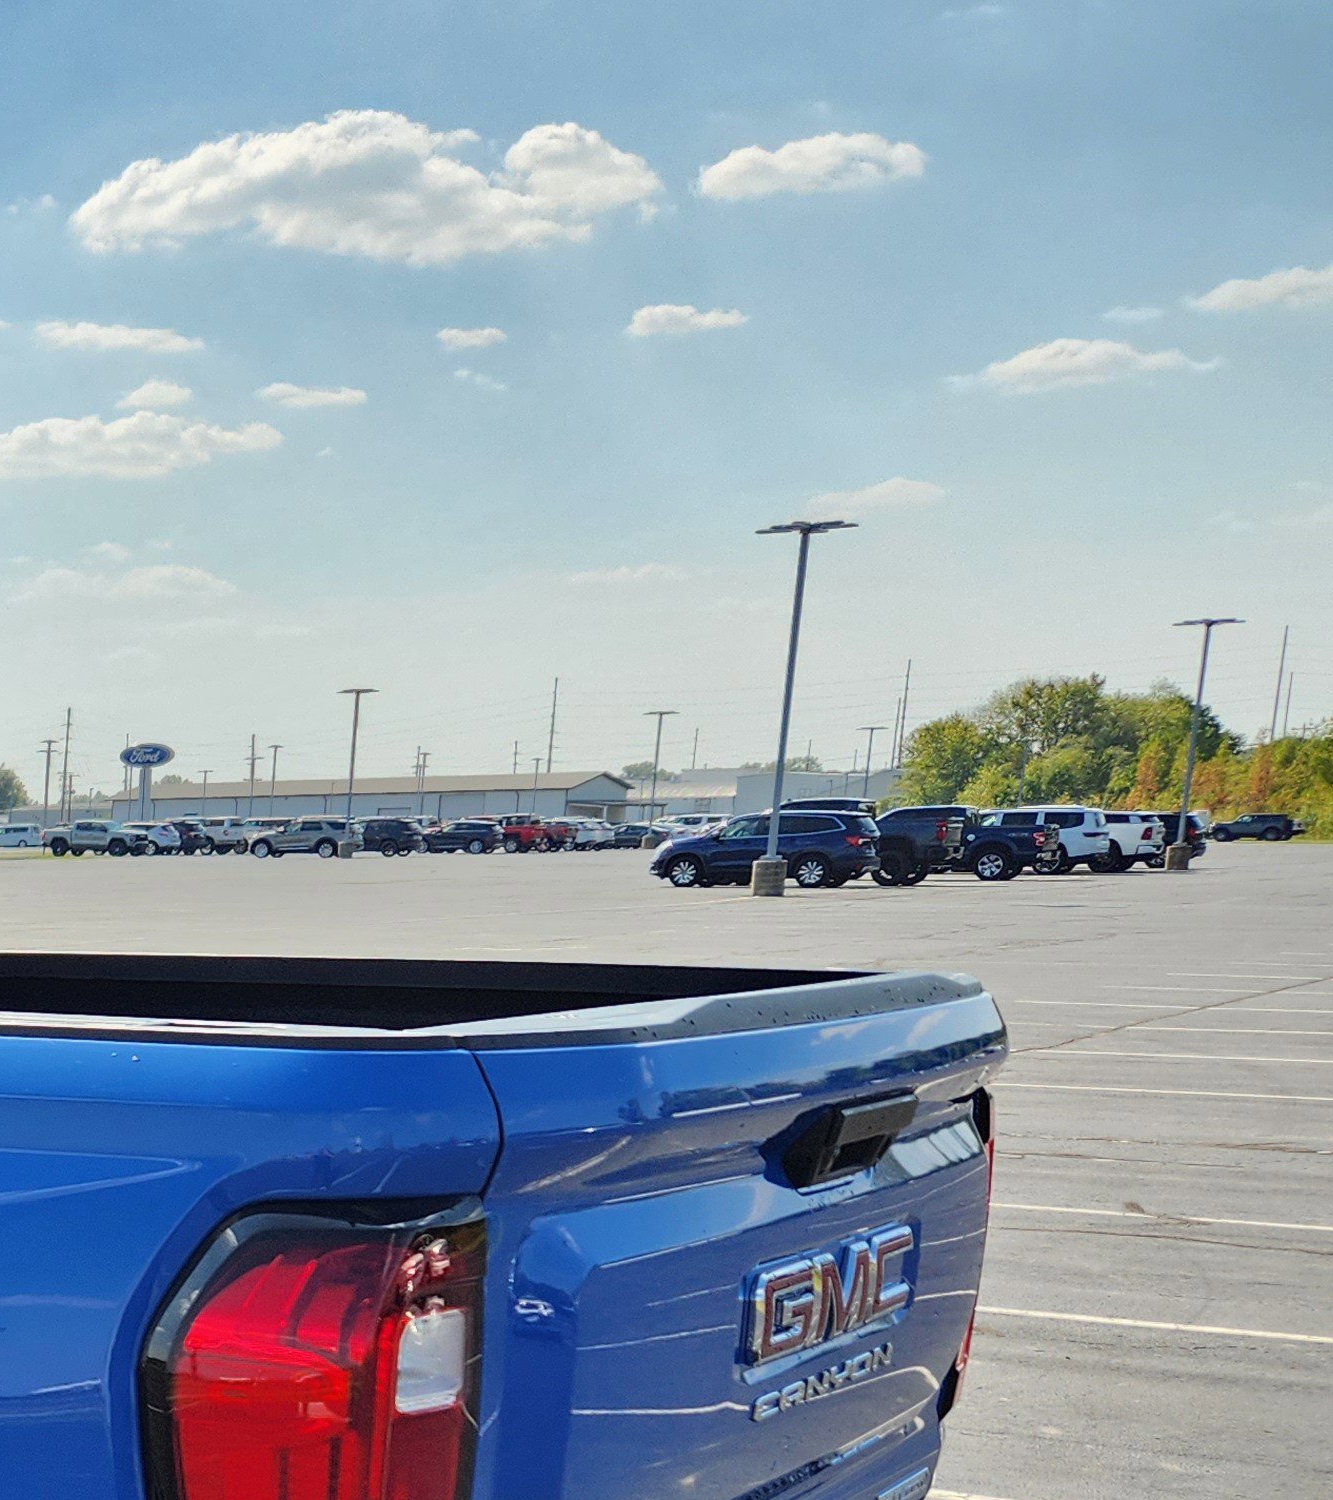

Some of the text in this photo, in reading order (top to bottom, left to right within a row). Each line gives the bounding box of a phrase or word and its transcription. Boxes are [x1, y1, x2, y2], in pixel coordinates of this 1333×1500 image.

[129, 747, 161, 763] Ford
[751, 1225, 914, 1367] GMC
[751, 1342, 893, 1422] CANYON
